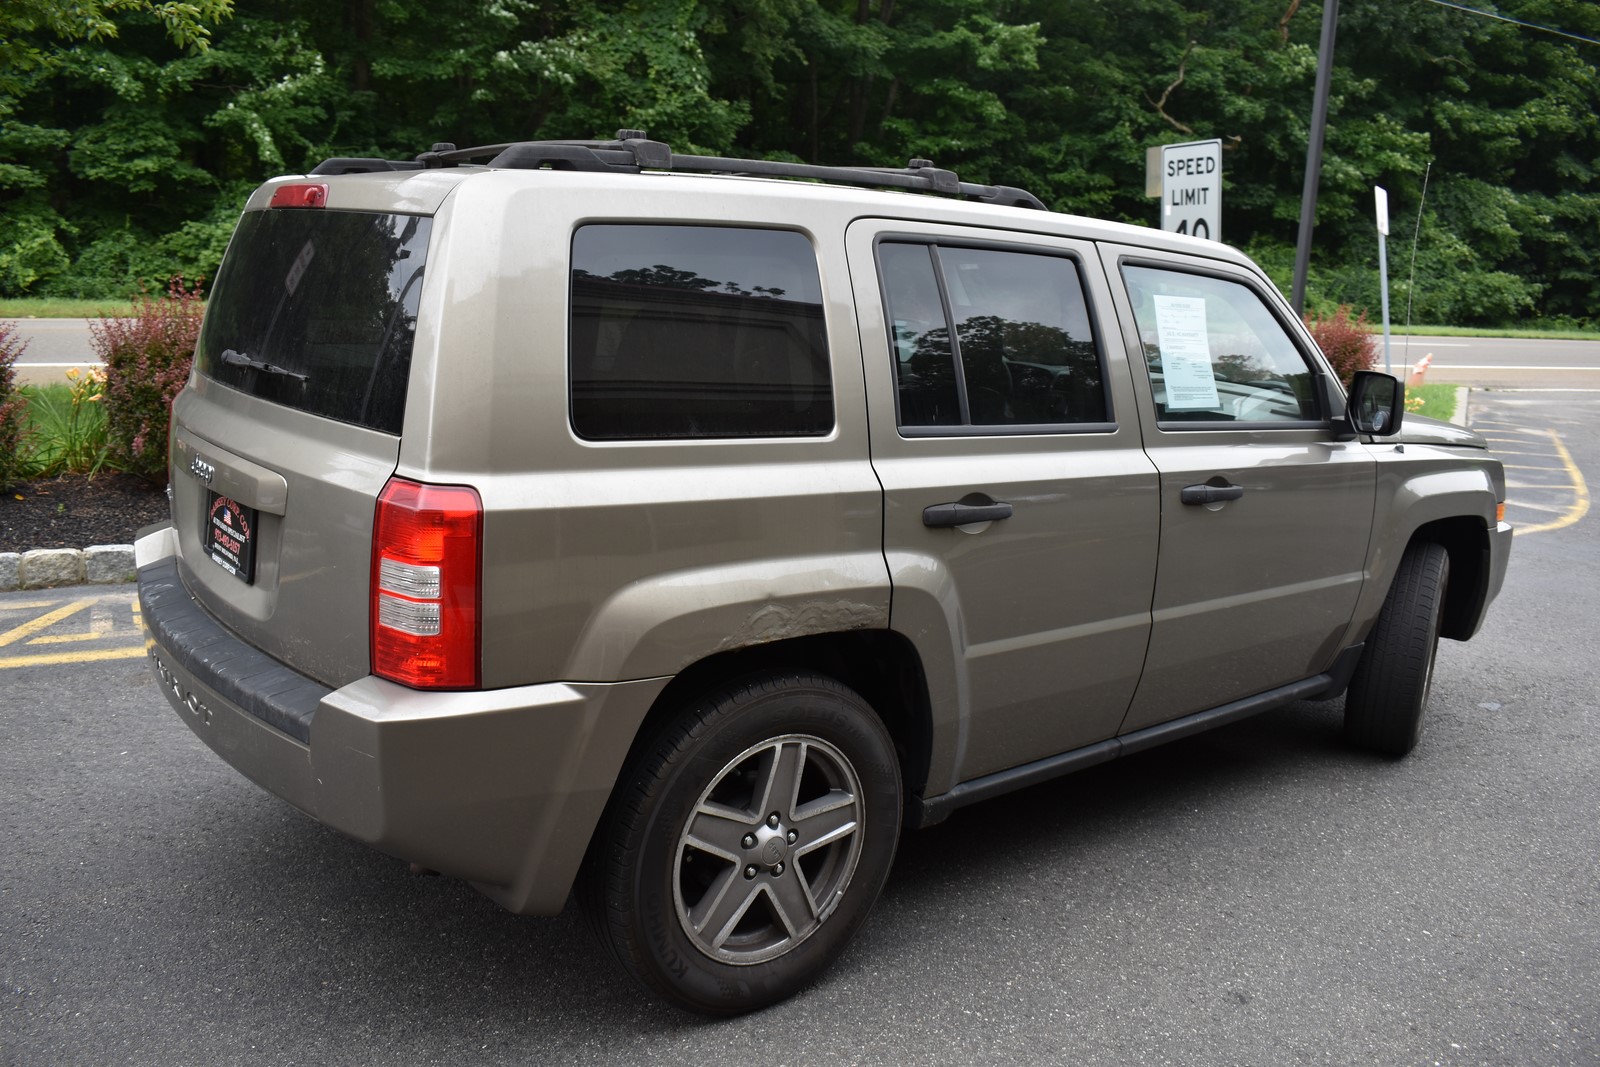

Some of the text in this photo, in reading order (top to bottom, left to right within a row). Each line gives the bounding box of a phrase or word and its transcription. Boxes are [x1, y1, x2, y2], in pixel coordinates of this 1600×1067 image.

[1167, 156, 1215, 177] SPEED
[1172, 187, 1209, 206] LIMIT
[191, 453, 215, 484] Jeep
